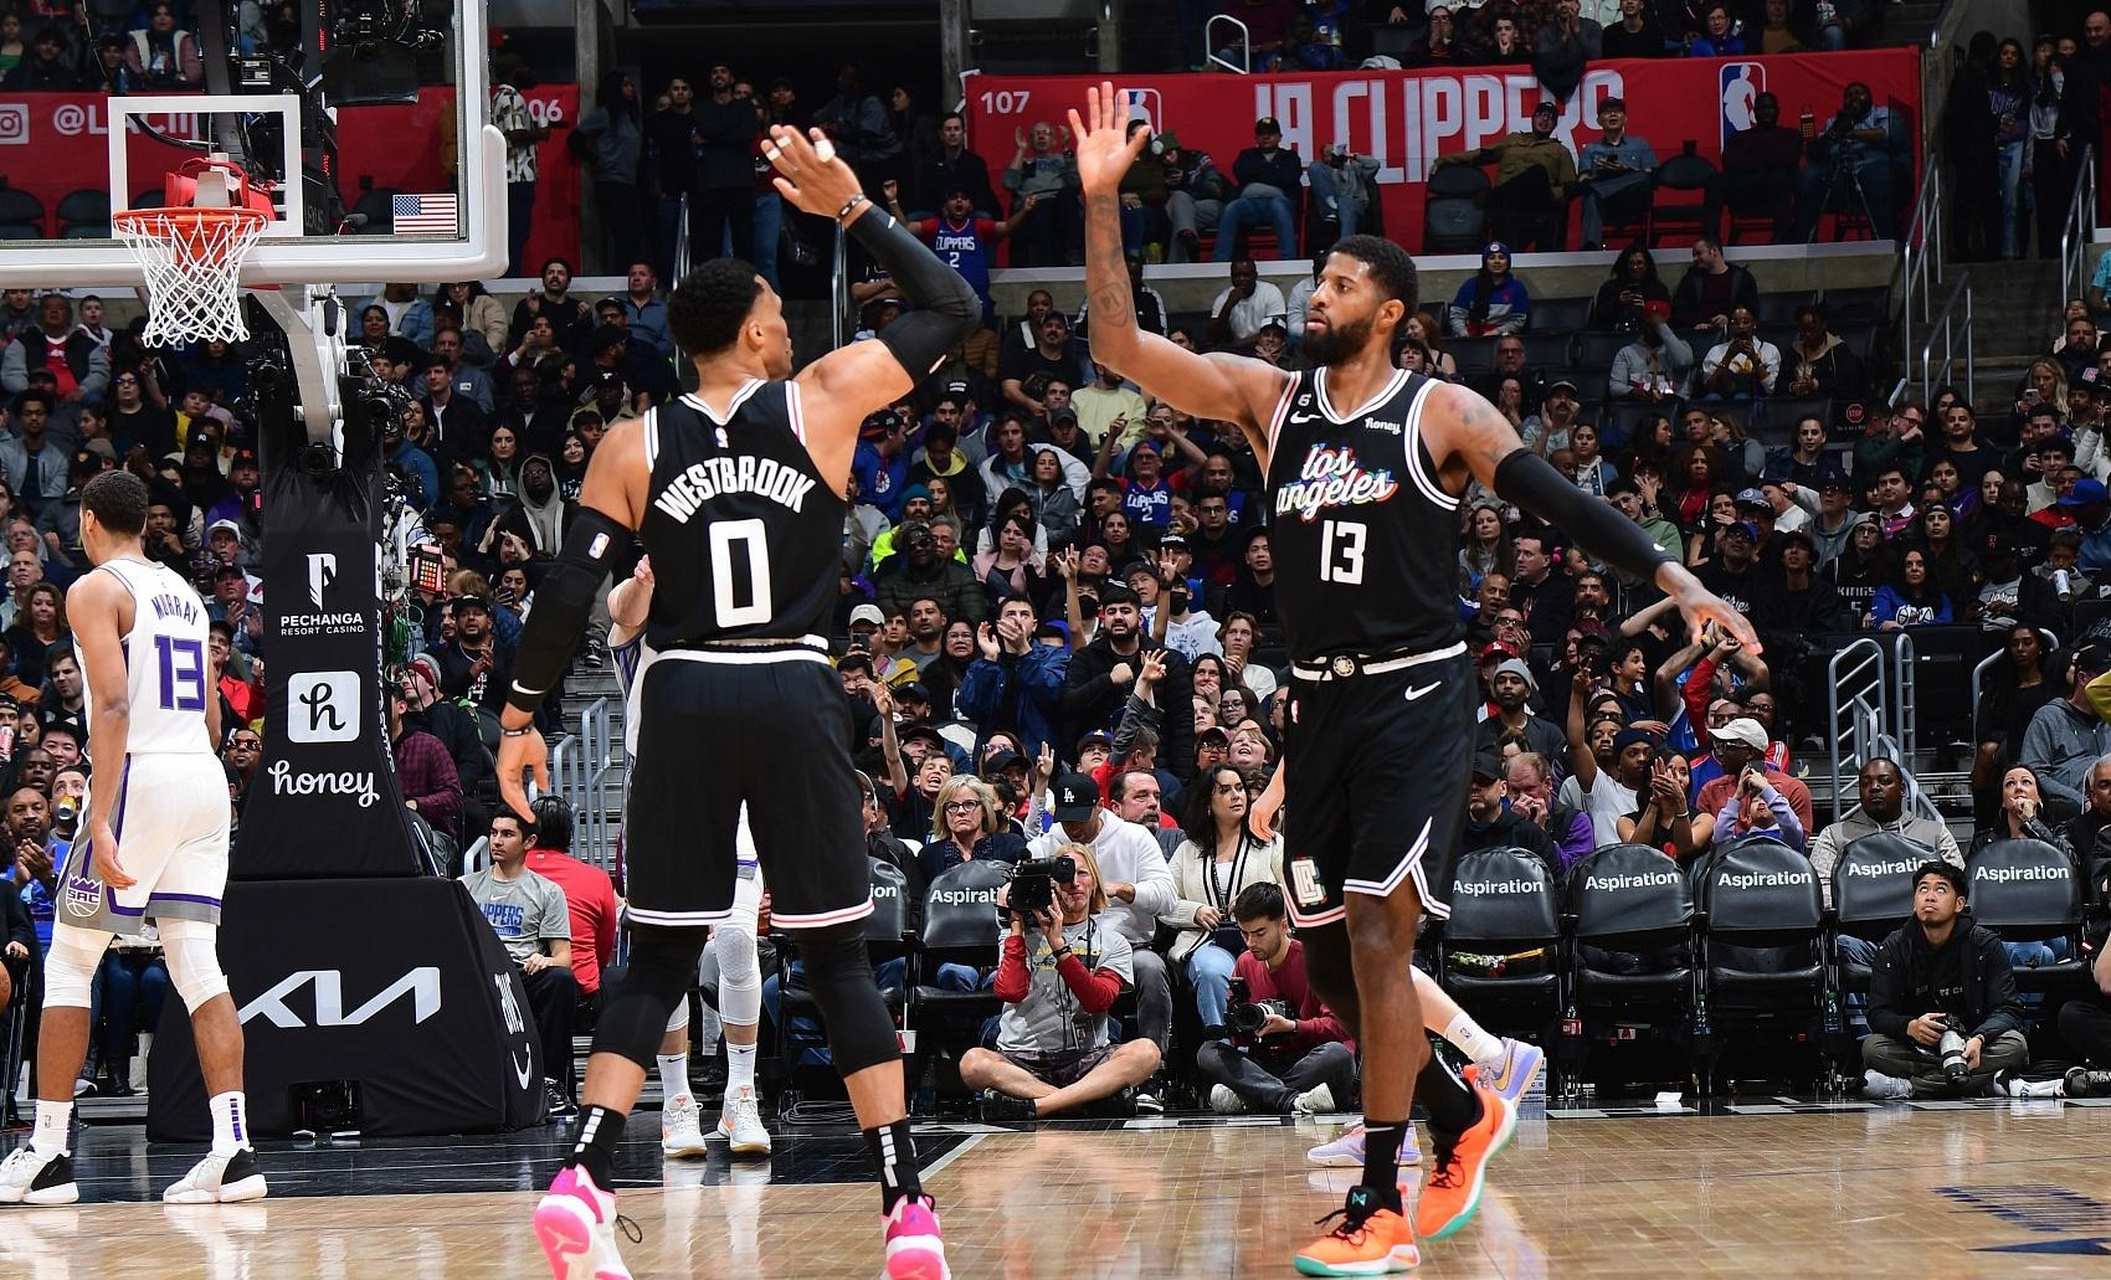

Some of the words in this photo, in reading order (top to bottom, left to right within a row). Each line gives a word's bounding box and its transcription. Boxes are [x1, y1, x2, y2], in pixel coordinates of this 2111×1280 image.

[528, 99, 563, 122] 06
[981, 91, 1030, 115] 107
[936, 236, 975, 251] CLIPPERS
[950, 252, 960, 268] 2
[1297, 394, 1312, 407] 6
[1364, 416, 1402, 436] honey
[1301, 444, 1357, 481] los
[654, 455, 816, 524] WESTBROOK
[1276, 468, 1396, 522] angeles
[1142, 504, 1153, 522] 2
[1320, 519, 1367, 585] 13
[709, 518, 772, 628] 0
[1837, 586, 1876, 597] KINGS
[151, 594, 198, 627] MURRAY
[281, 613, 364, 628] PECHANGA
[281, 627, 321, 637] RESORT
[326, 625, 365, 635] CASINO
[154, 634, 206, 713] 13
[268, 760, 381, 808] honey
[1063, 787, 1075, 803] LA
[1585, 870, 1680, 892] Aspiration
[1718, 870, 1813, 890] Aspiration
[1975, 864, 2070, 884] Aspiration
[67, 889, 100, 904] SAC
[1452, 878, 1544, 898] Aspiration
[238, 966, 441, 1028] KIA
